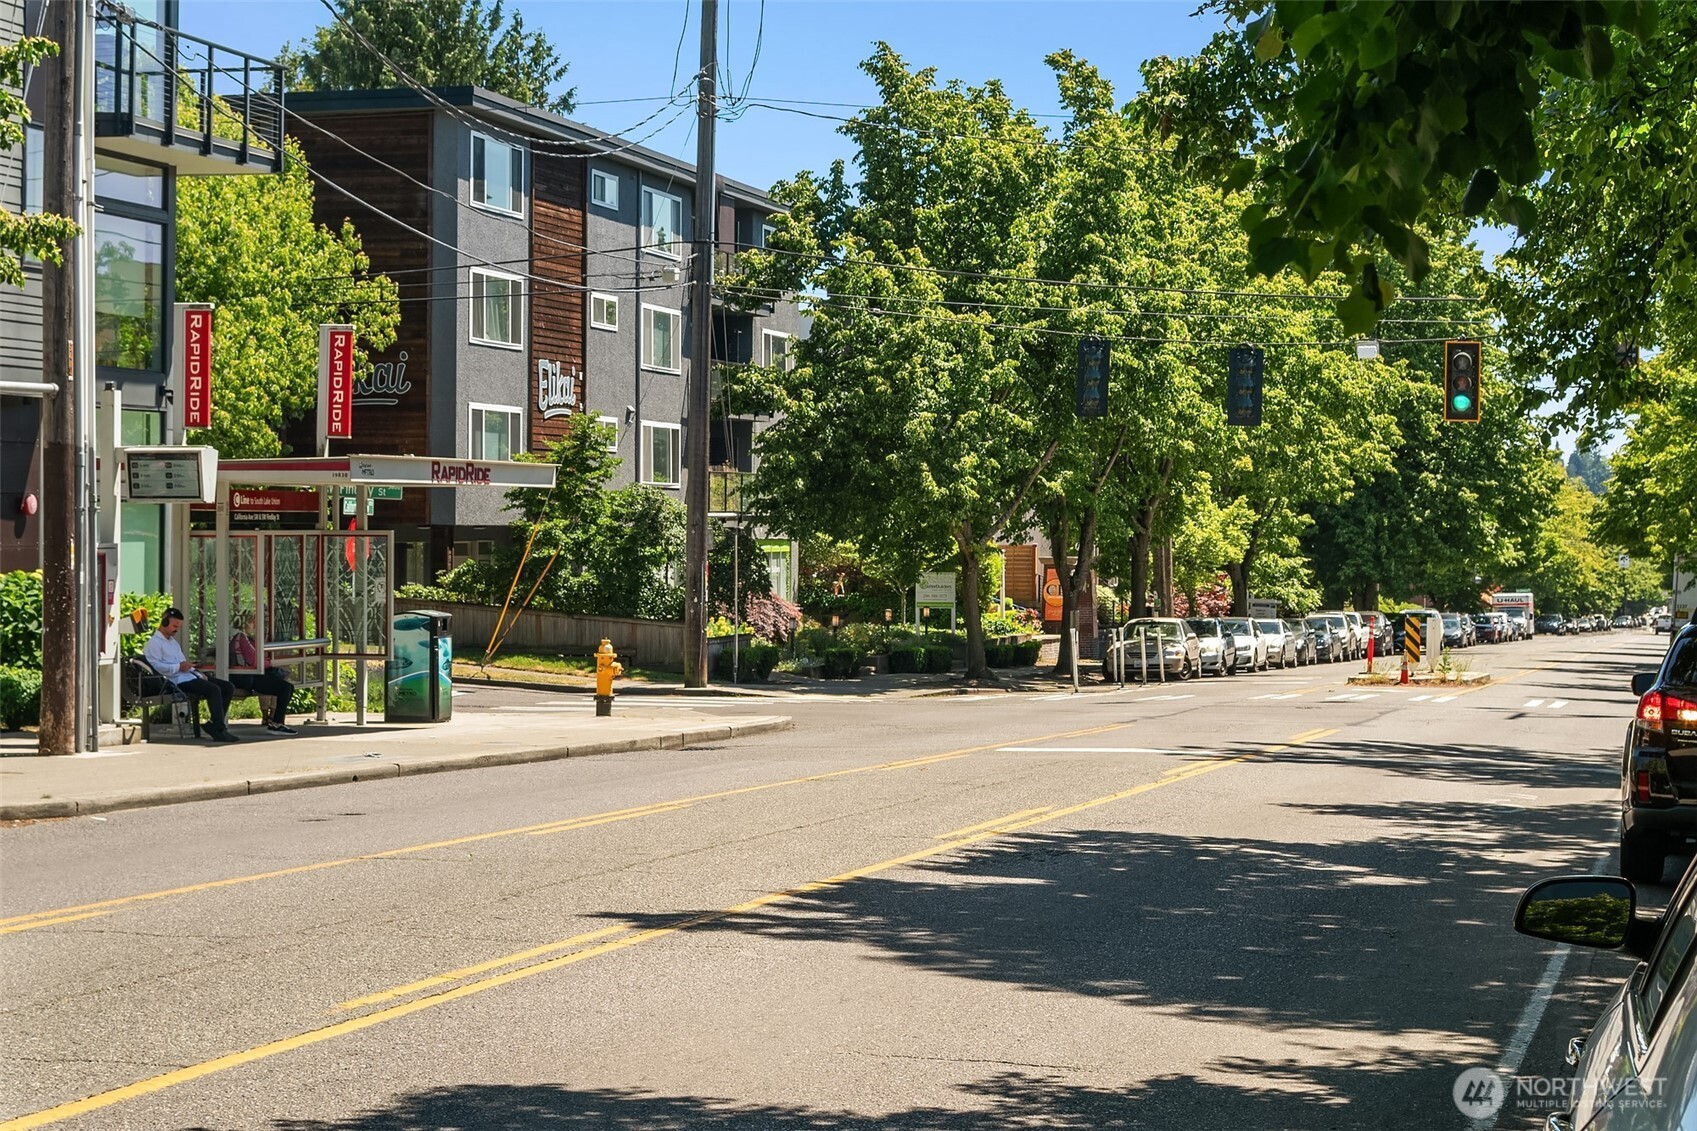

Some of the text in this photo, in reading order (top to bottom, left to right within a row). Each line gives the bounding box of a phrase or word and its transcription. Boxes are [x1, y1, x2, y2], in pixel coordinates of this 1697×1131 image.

[538, 359, 577, 411] Elikai
[378, 487, 387, 497] St
[240, 495, 250, 505] Line
